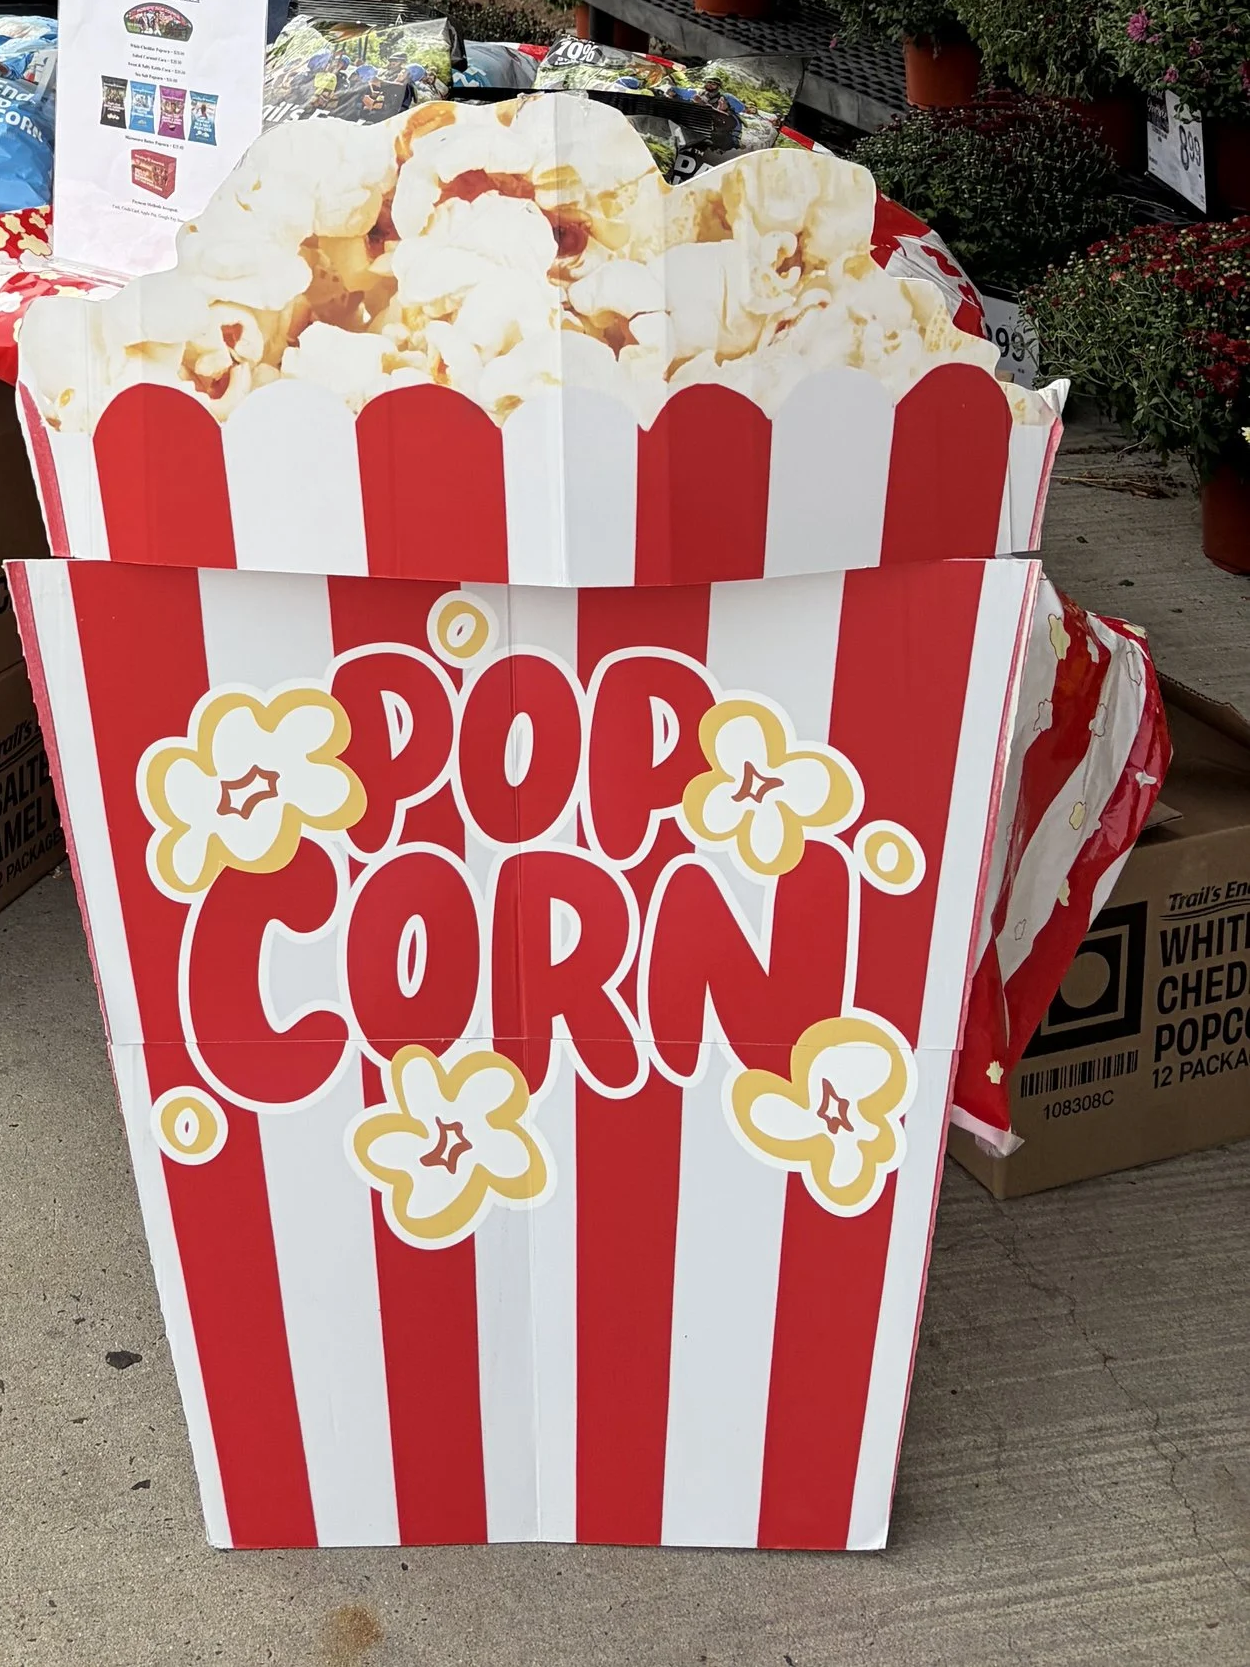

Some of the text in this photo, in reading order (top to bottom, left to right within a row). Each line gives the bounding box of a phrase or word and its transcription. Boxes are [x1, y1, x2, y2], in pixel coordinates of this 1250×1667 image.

[554, 37, 599, 63] 70%
[330, 647, 723, 866] POP
[6, 827, 66, 880] PACKAGE
[1168, 885, 1222, 912] Trail's
[186, 837, 854, 1106] CORN
[1157, 960, 1250, 1015] CHED
[1152, 1047, 1250, 1089] 12 PACKA
[1043, 1089, 1114, 1121] 108308C
